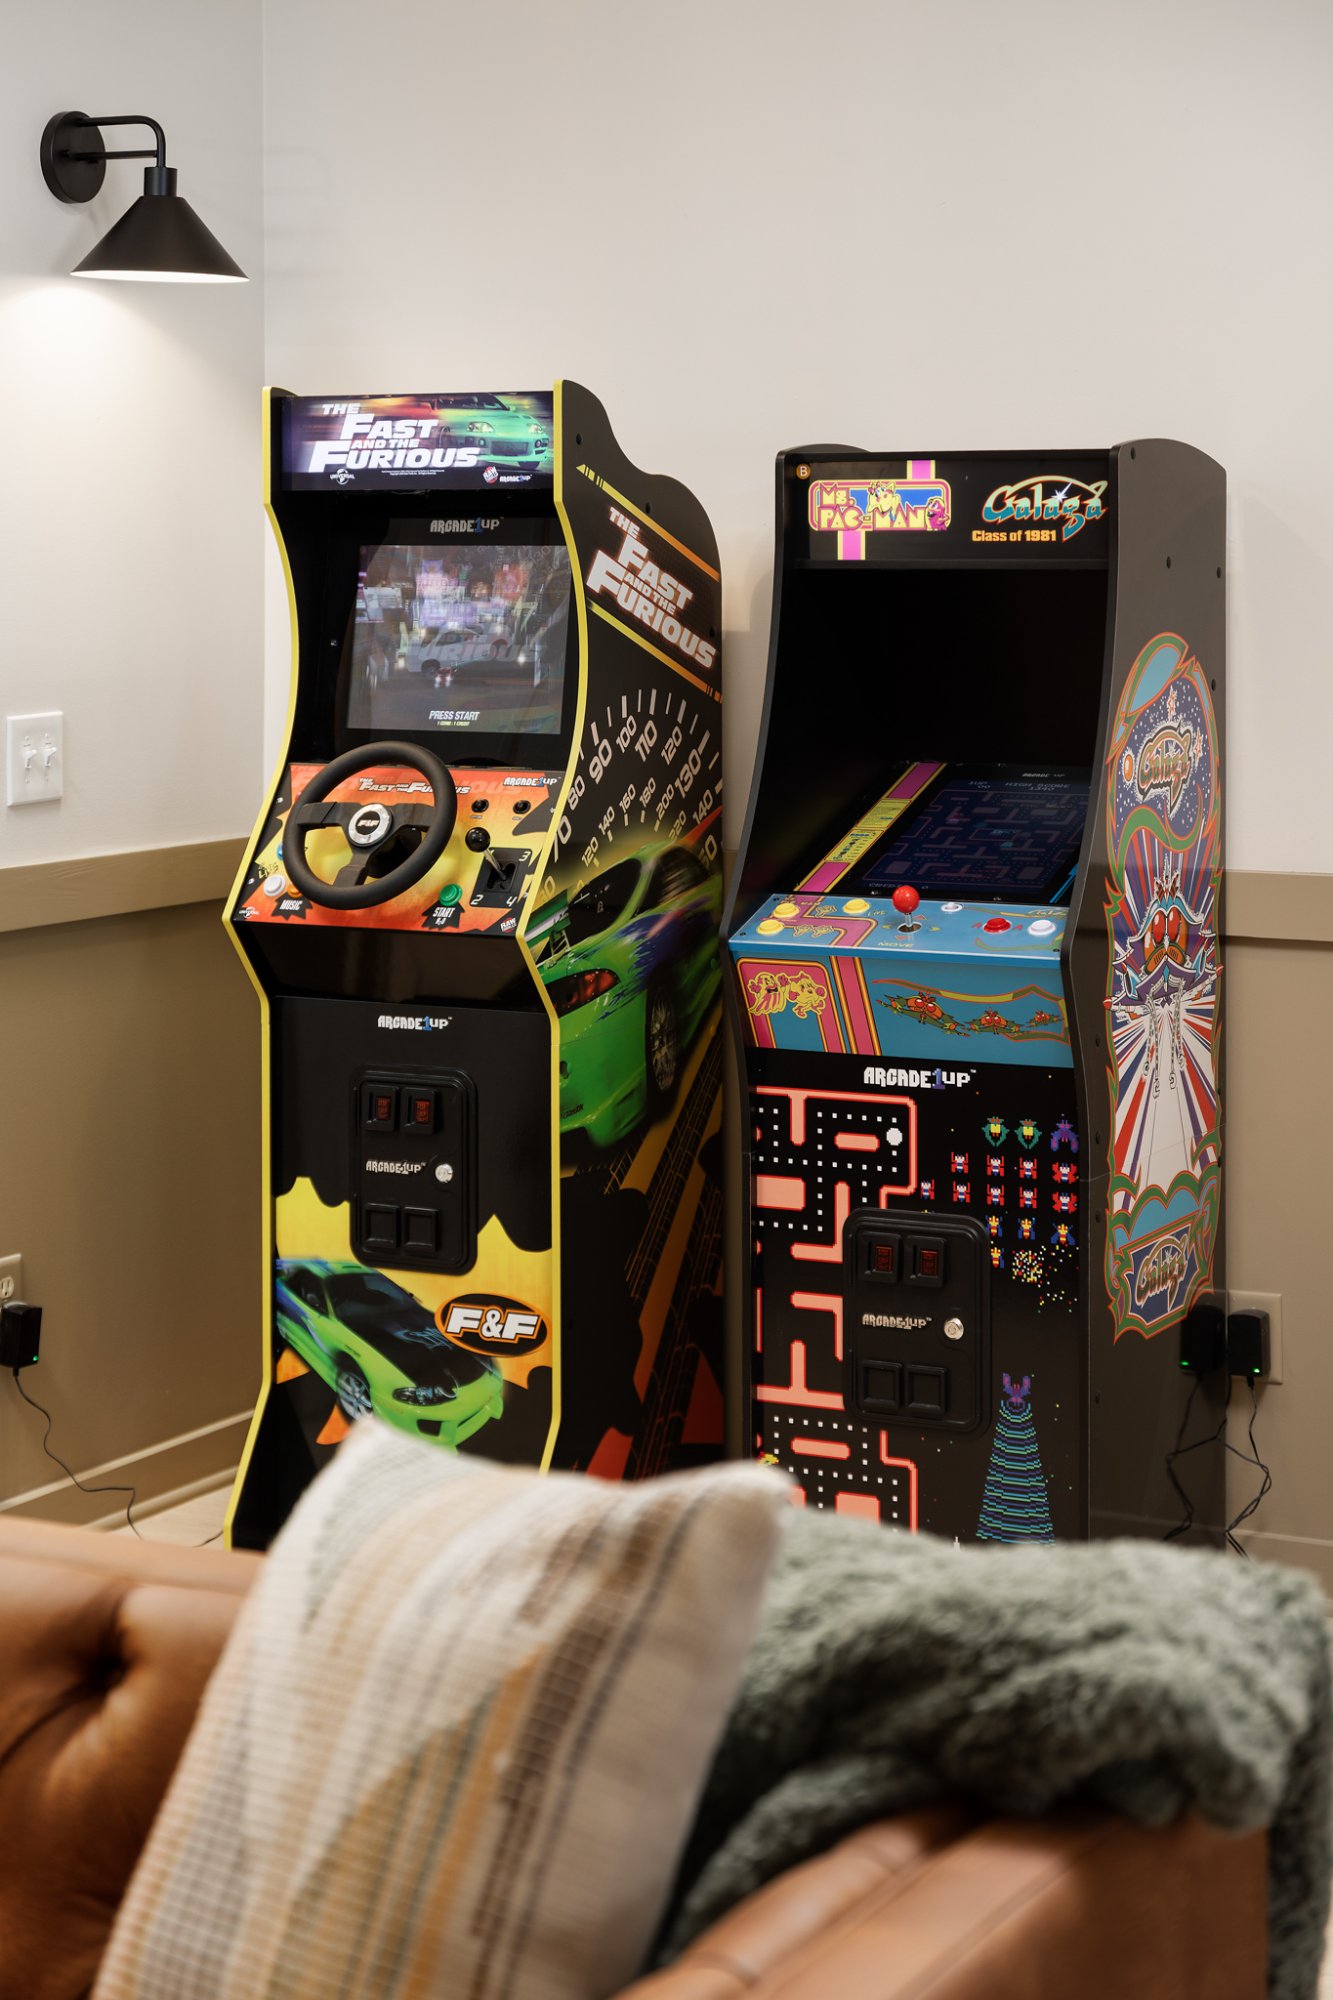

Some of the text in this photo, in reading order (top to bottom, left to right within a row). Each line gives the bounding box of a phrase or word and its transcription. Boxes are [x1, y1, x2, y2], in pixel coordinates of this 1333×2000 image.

[321, 403, 361, 415] THE
[340, 413, 439, 440] FAST
[308, 441, 480, 473] FURIOUS
[350, 439, 420, 449] AND THE
[799, 465, 808, 477] B
[609, 506, 641, 538] THE
[982, 475, 1109, 542] Galaga
[430, 517, 500, 534] ARCADE1UP
[972, 530, 1057, 542] Class of 1981
[617, 533, 694, 610] FAST
[586, 550, 717, 668] FURIOUS
[625, 573, 677, 615] AND THE
[429, 711, 480, 720] PRESS START
[616, 715, 637, 753] 100
[634, 720, 658, 763] 110
[660, 726, 683, 765] 120
[589, 738, 613, 784] 90
[674, 748, 700, 798] 130
[567, 775, 586, 811] 80
[619, 783, 636, 814] 160
[639, 777, 656, 808] 180
[656, 784, 675, 818] 200
[692, 789, 714, 826] 140
[598, 806, 615, 836] 140
[518, 850, 531, 862] 3
[581, 836, 599, 868] 120
[280, 900, 303, 910] MUSIC
[432, 907, 455, 918] START
[470, 894, 484, 905] 2
[506, 896, 518, 907] 4
[377, 1015, 449, 1031] ARCADE1UP
[863, 1066, 971, 1089] ARCADE1UP
[366, 1160, 422, 1175] ARCADE1UP
[446, 1306, 540, 1340] F&F
[862, 1313, 928, 1330] ARCADE1UP
